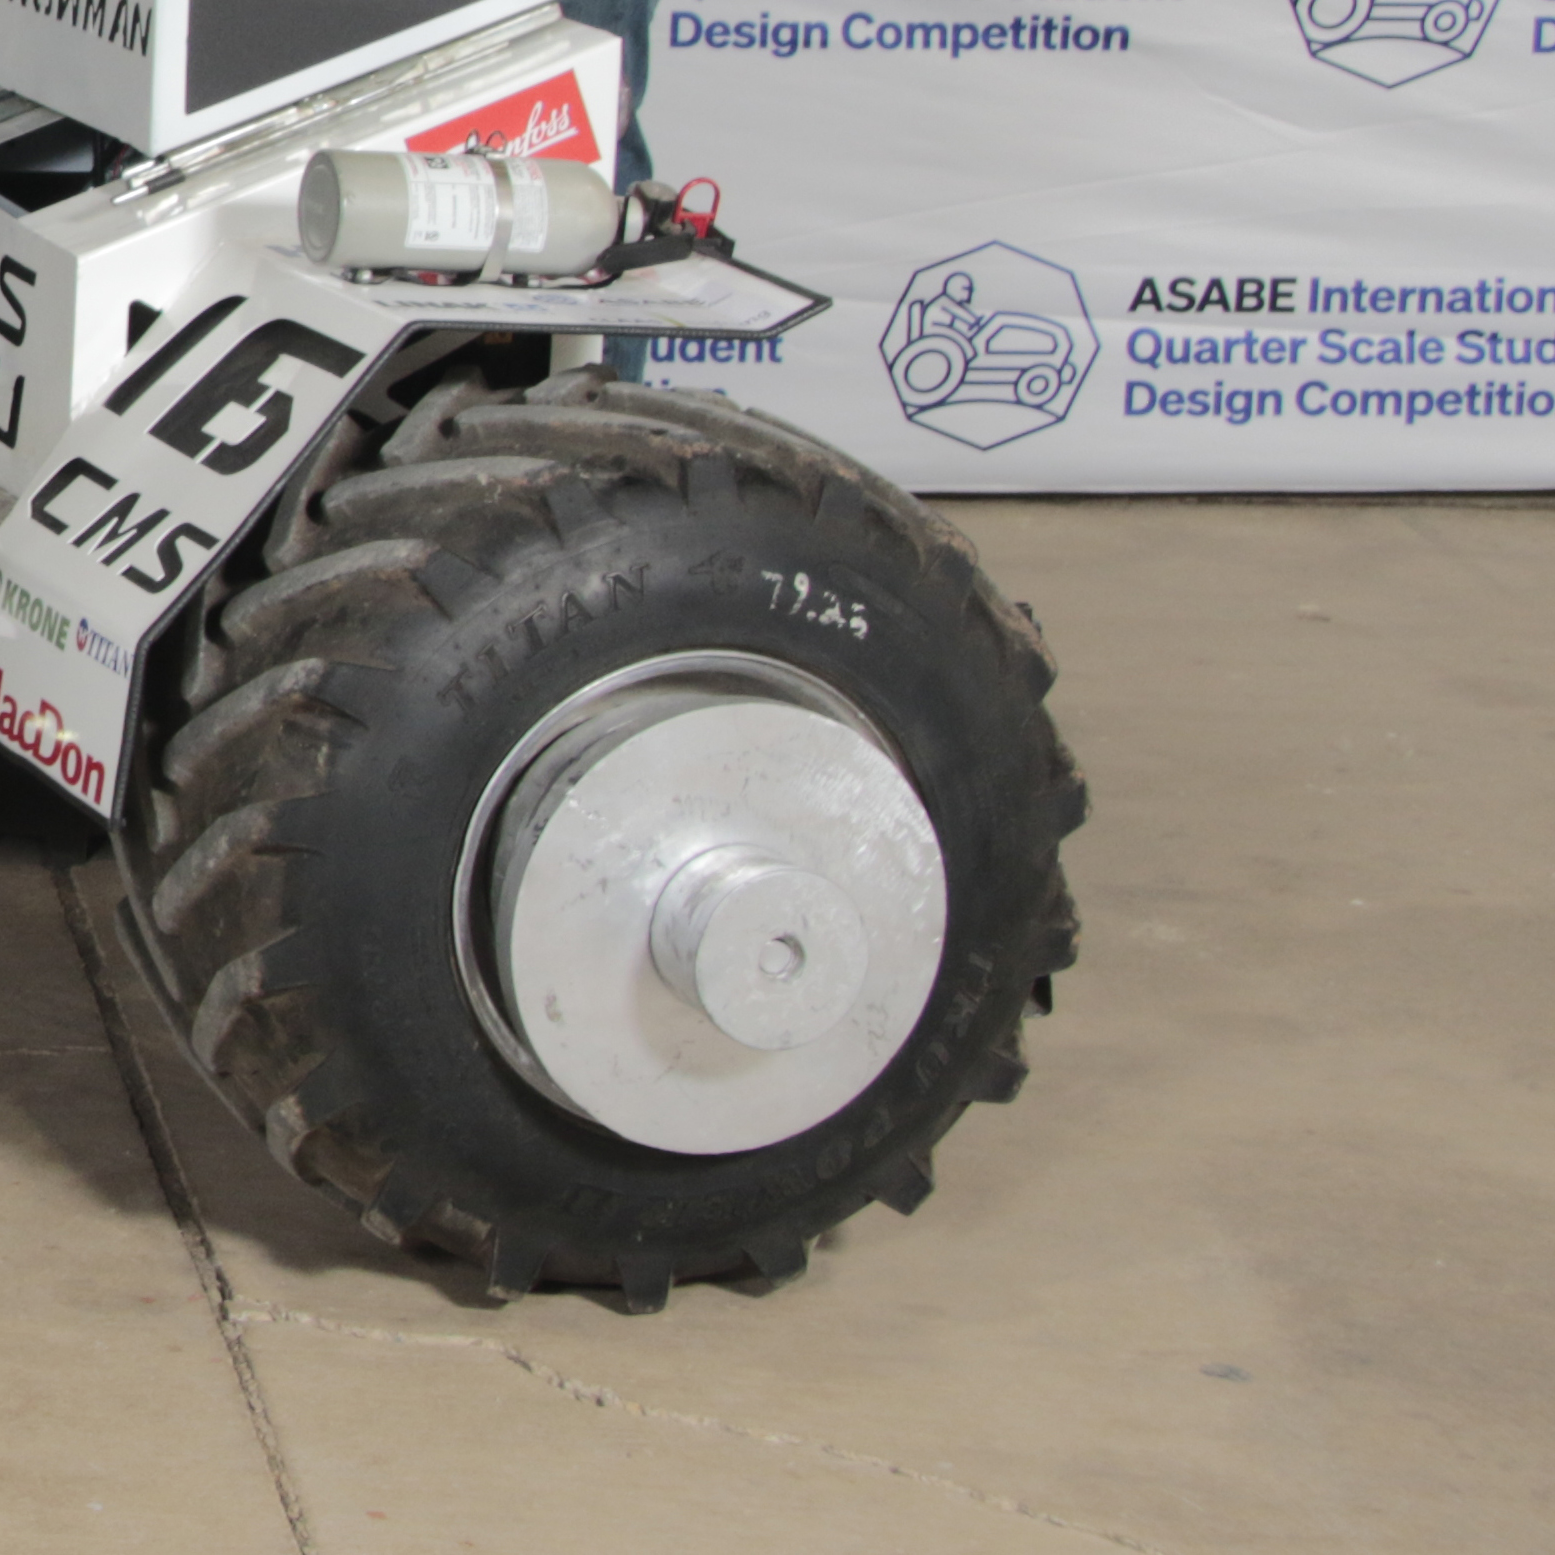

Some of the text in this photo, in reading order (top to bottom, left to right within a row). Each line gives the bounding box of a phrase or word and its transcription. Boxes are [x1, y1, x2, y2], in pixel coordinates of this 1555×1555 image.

[669, 11, 1130, 59] Design Competition
[1127, 276, 1555, 314] ASABE Internation
[1127, 328, 1307, 370] Quarter
[1318, 328, 1444, 365] Scale
[103, 295, 367, 475] 16
[1124, 380, 1555, 425] Design Competitio
[30, 456, 221, 595] CMS
[1, 579, 135, 679] KRONE TITAN
